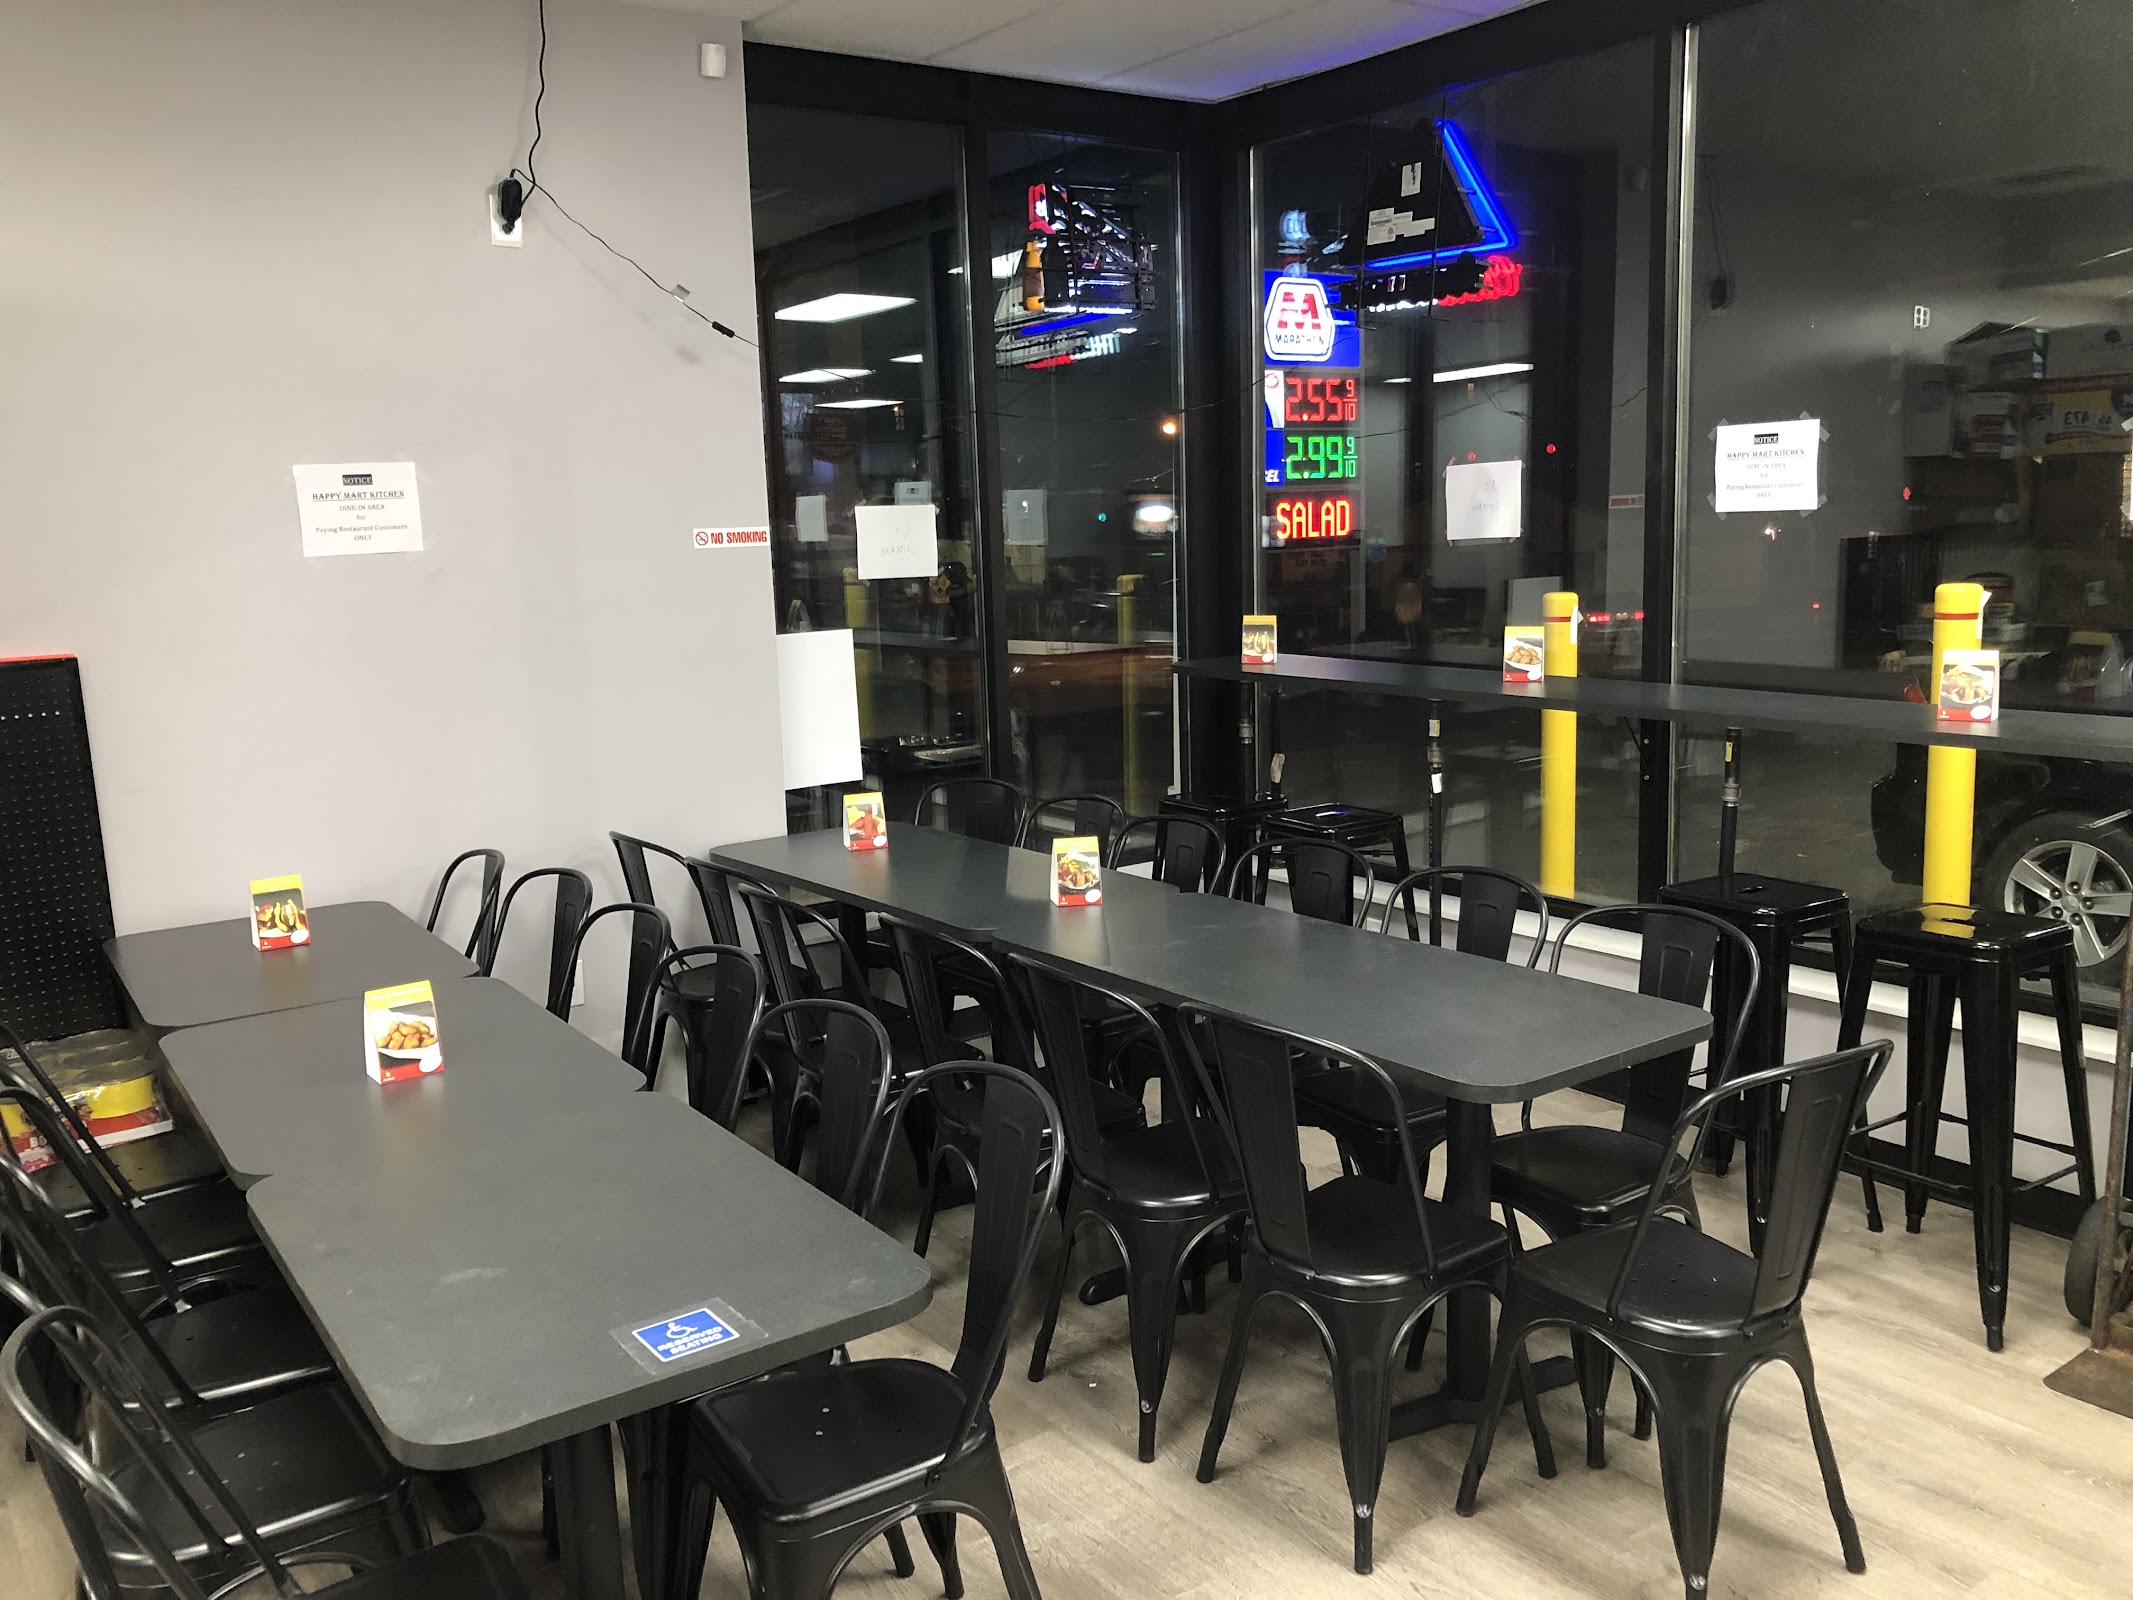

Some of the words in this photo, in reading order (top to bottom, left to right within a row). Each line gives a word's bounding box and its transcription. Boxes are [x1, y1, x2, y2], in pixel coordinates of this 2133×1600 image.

[1285, 378, 1342, 421] 2.55
[1754, 436, 1778, 444] NOTICE
[1286, 437, 1342, 479] 2.99
[1727, 451, 1750, 459] HAPPY
[1752, 450, 1772, 458] MART
[1774, 449, 1805, 457] KITCHEN
[1265, 469, 1279, 483] EL
[343, 477, 373, 486] NOTICE
[312, 492, 341, 500] HAPPY
[343, 491, 367, 499] MART
[370, 490, 405, 499] KITCHEN
[339, 504, 366, 512] DINE-IN
[367, 503, 385, 511] AREA
[1275, 500, 1351, 540] SALAD
[315, 526, 338, 535] Paying
[338, 525, 374, 533] Restaurant
[710, 532, 724, 544] NO
[726, 530, 768, 544] SMOKING
